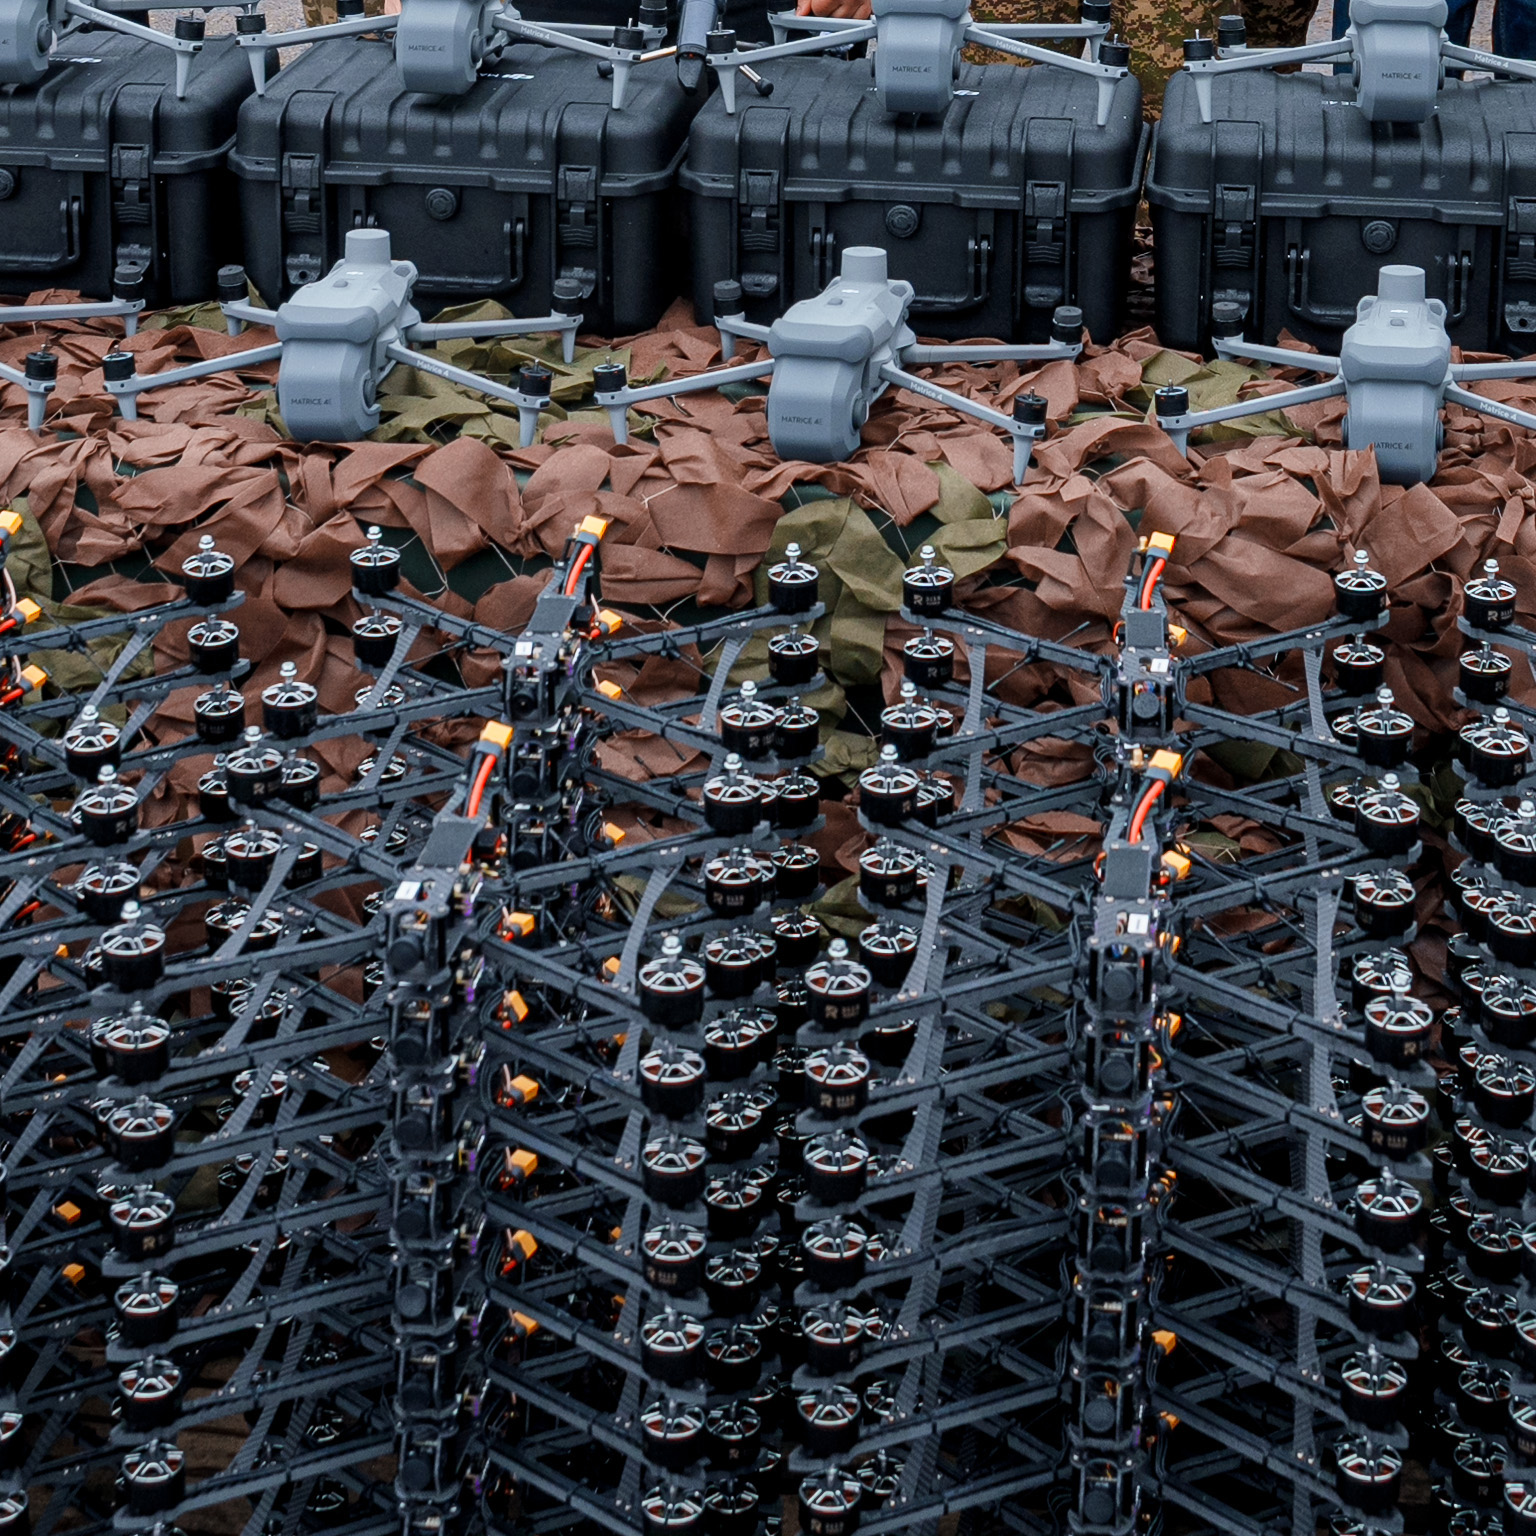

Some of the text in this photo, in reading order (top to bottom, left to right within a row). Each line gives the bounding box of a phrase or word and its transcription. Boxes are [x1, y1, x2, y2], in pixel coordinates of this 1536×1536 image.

[520, 26, 544, 38] Matrice
[995, 40, 1022, 53] Matrice
[1474, 54, 1501, 66] Matrice
[1382, 72, 1411, 80] MATRICE
[416, 359, 443, 374] Matrice
[910, 382, 936, 398] Matrice
[1480, 402, 1509, 418] Matrice
[781, 416, 812, 425] MATRICE
